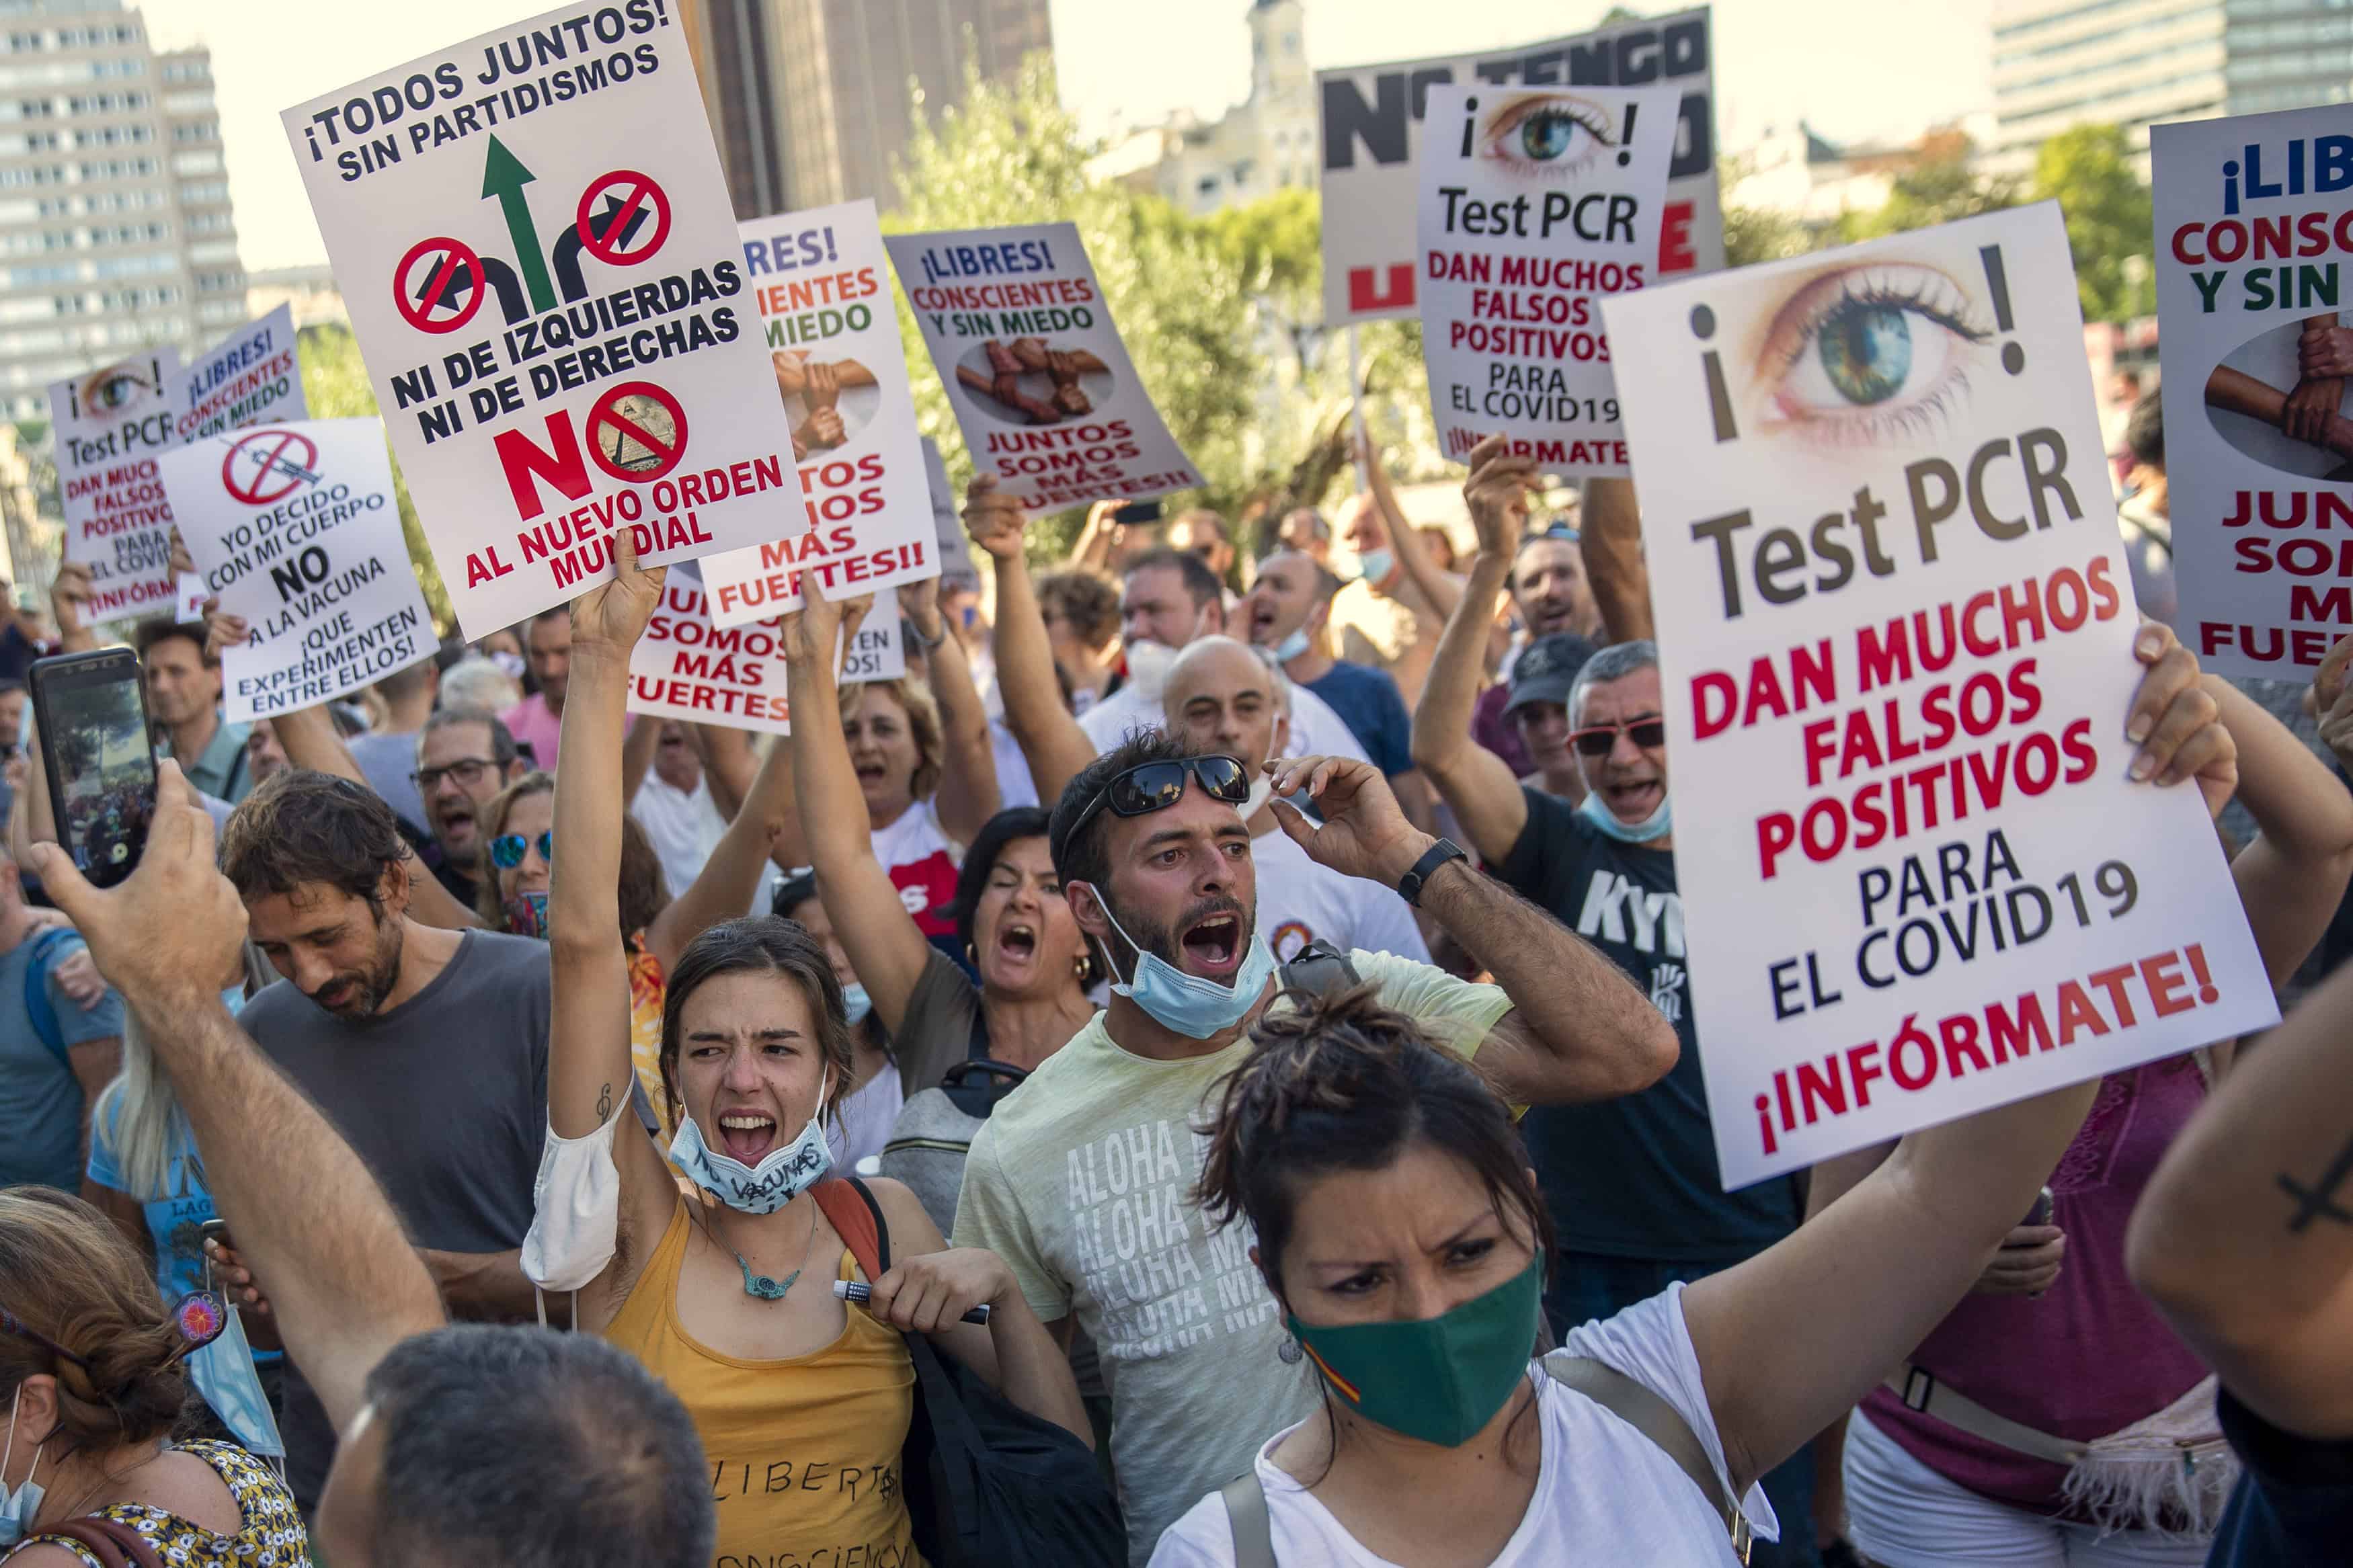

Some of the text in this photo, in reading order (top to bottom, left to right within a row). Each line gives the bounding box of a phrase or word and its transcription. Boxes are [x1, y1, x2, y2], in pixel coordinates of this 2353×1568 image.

[304, 0, 670, 162] ¡TODOS JUNTOS!
[337, 43, 660, 182] SIN PARTIDISMOS
[1438, 188, 1529, 238] Test
[1540, 191, 1638, 243] PCR
[921, 239, 1055, 283] ¡LIBRES!
[1428, 250, 1644, 292] DAN MUCHOS
[2190, 263, 2338, 313] Y SIN
[913, 278, 1093, 310] CONSCIENTES
[929, 306, 1094, 338] Y SIN MIEDO
[1472, 288, 1589, 325] FALSOS
[390, 260, 742, 409] NI DE IZQUIERDAS
[1451, 320, 1610, 362] POSITIVOS
[177, 349, 292, 436] CONSCIENTES
[230, 376, 290, 425] MIEDO
[417, 306, 740, 444] NI DE DERECHAS
[1451, 383, 1620, 423] EL COVID19
[1490, 362, 1567, 393] PARA
[66, 430, 118, 467] Test
[988, 419, 1133, 454] JUNTOS
[996, 441, 1141, 479] SOMOS
[67, 473, 102, 501] DAN
[94, 481, 166, 513] FALSOS
[208, 493, 386, 592] CON MI CUERPO
[221, 483, 350, 554] YO DECIDO
[466, 455, 783, 589] AL NUEVO ORDEN
[1691, 427, 2084, 621] Test PCR
[270, 545, 330, 604] NO
[760, 526, 857, 571] MÁS
[249, 556, 387, 649] A LA VACUNA
[238, 605, 420, 697] EXPERIMENTEN
[302, 610, 354, 661] ¡QUE
[1689, 555, 2120, 741] DAN MUCHOS
[2200, 621, 2352, 667] FUE
[252, 635, 417, 713] ENTRE ELLOS!
[629, 673, 790, 723] UERTES
[1804, 658, 2042, 787] FALSOS
[1755, 718, 2098, 881] POSITIVOS
[1858, 828, 2023, 928] PARA
[1767, 858, 2139, 1022] EL COVID19
[1754, 944, 2220, 1157] ¡INFÓRMATE!
[1067, 1120, 1181, 1211] ALOHA
[1074, 1183, 1190, 1273] ALOHA
